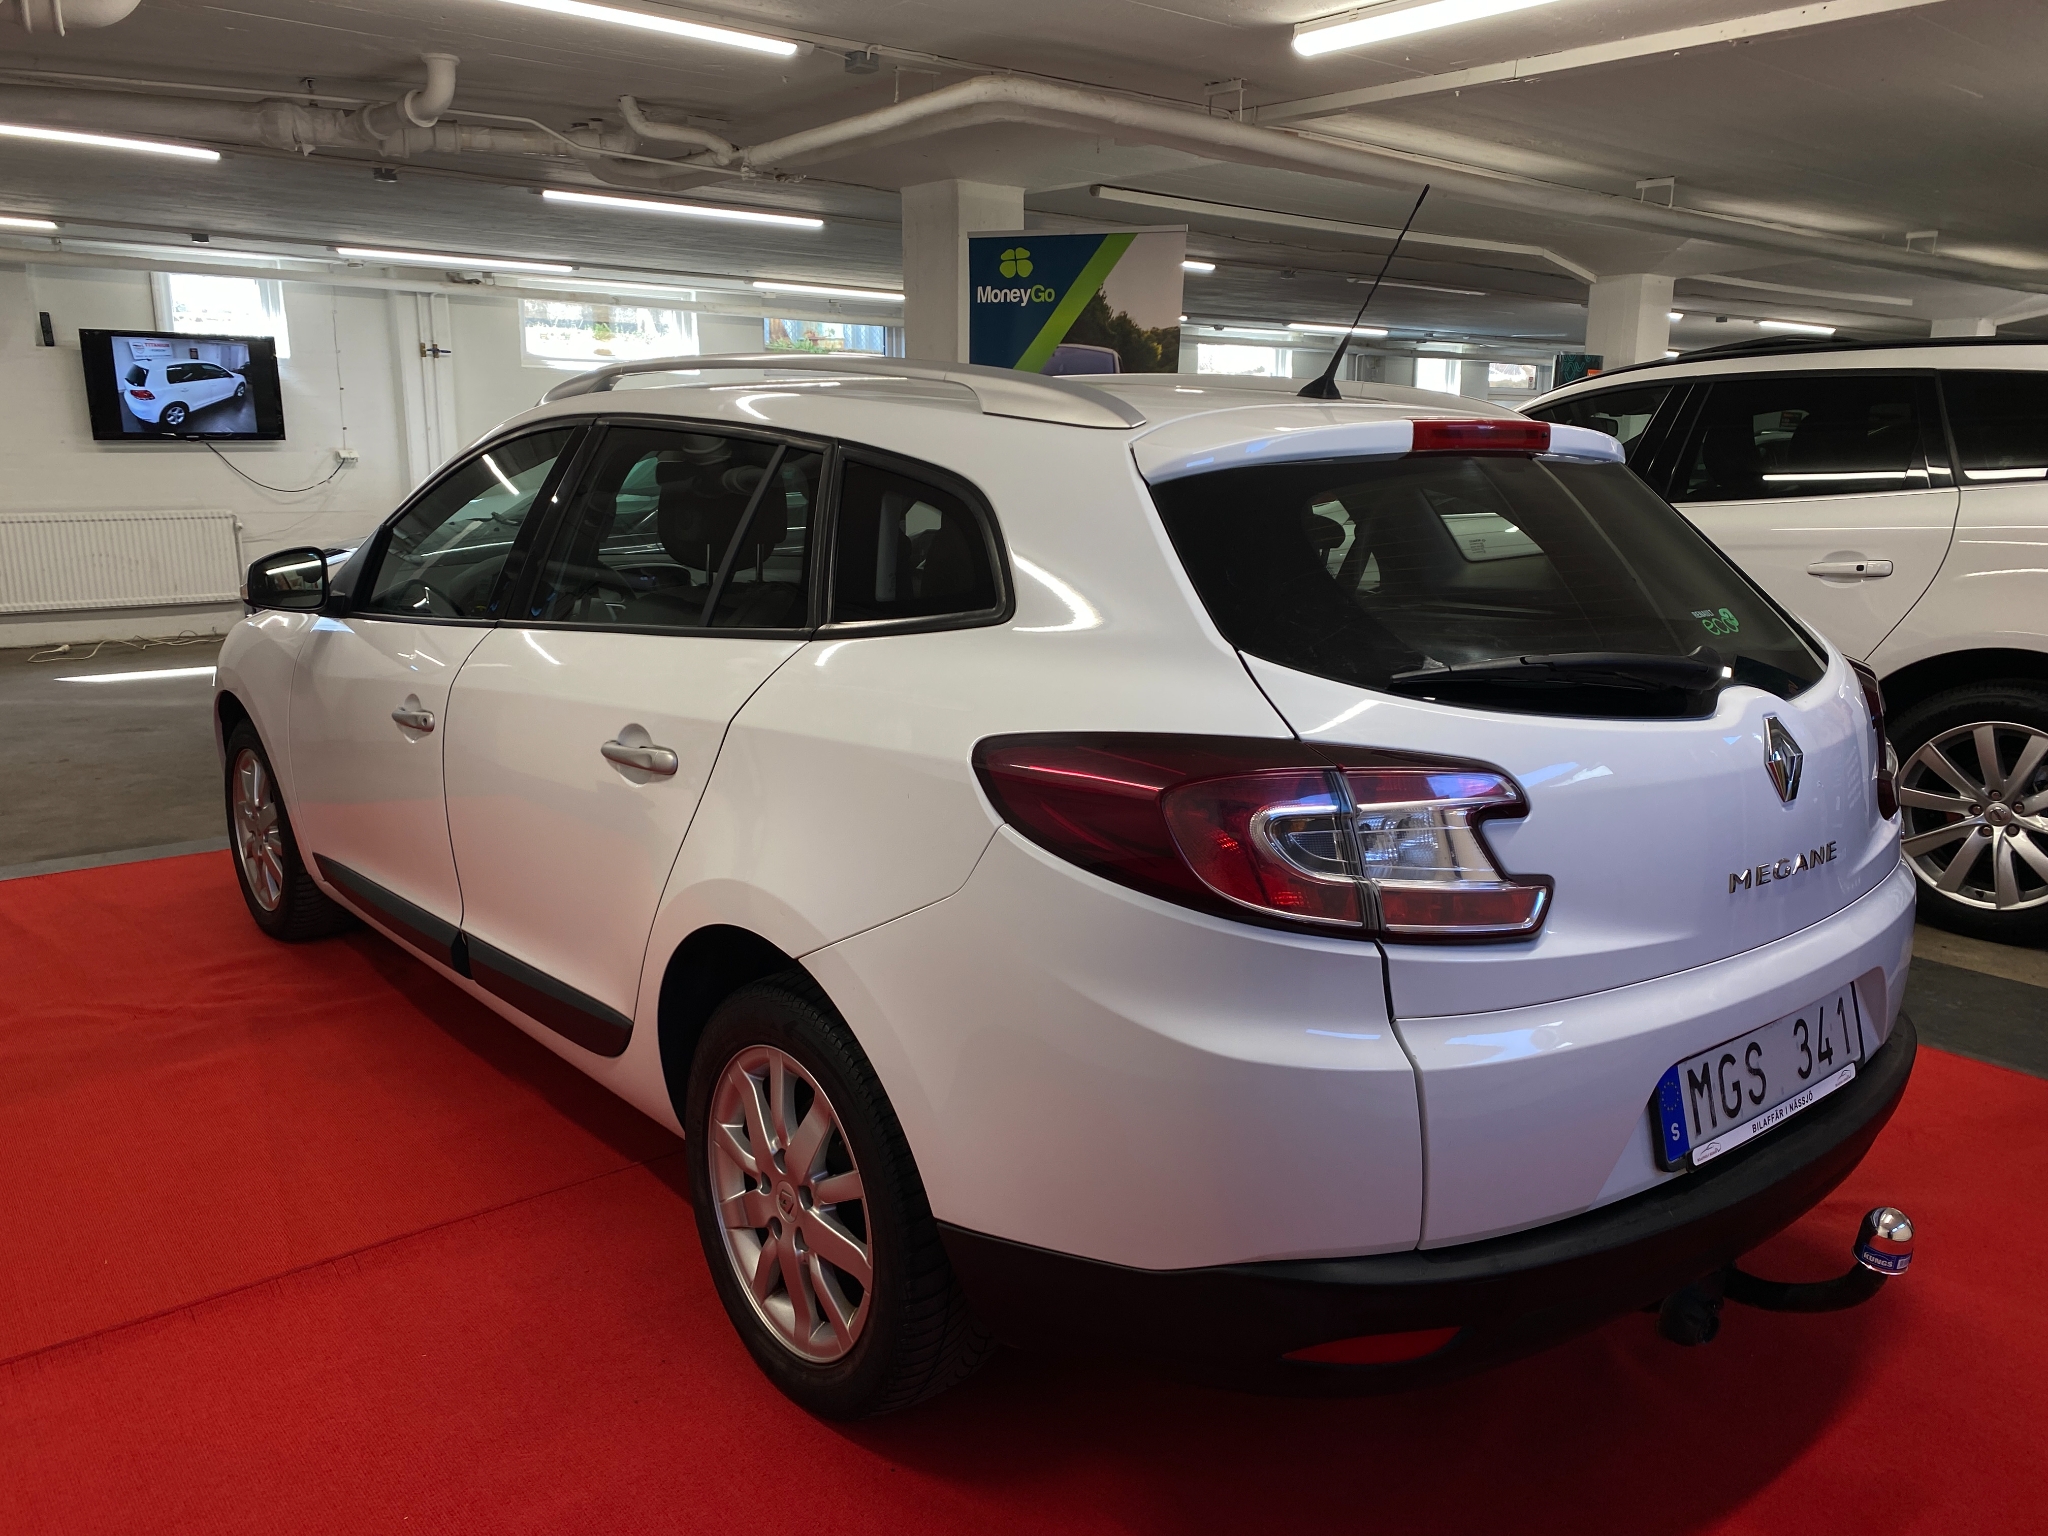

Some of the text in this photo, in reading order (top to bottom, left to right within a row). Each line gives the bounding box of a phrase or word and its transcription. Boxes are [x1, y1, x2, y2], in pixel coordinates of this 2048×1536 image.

[976, 284, 1056, 306] MoneyGo
[1728, 840, 1838, 894] MEGANE
[1687, 996, 1851, 1136] MGS 341
[1670, 1122, 1681, 1141] S
[1751, 1109, 1784, 1133] BILAFFÄR
[1789, 1090, 1814, 1112] NÄSSJÖ
